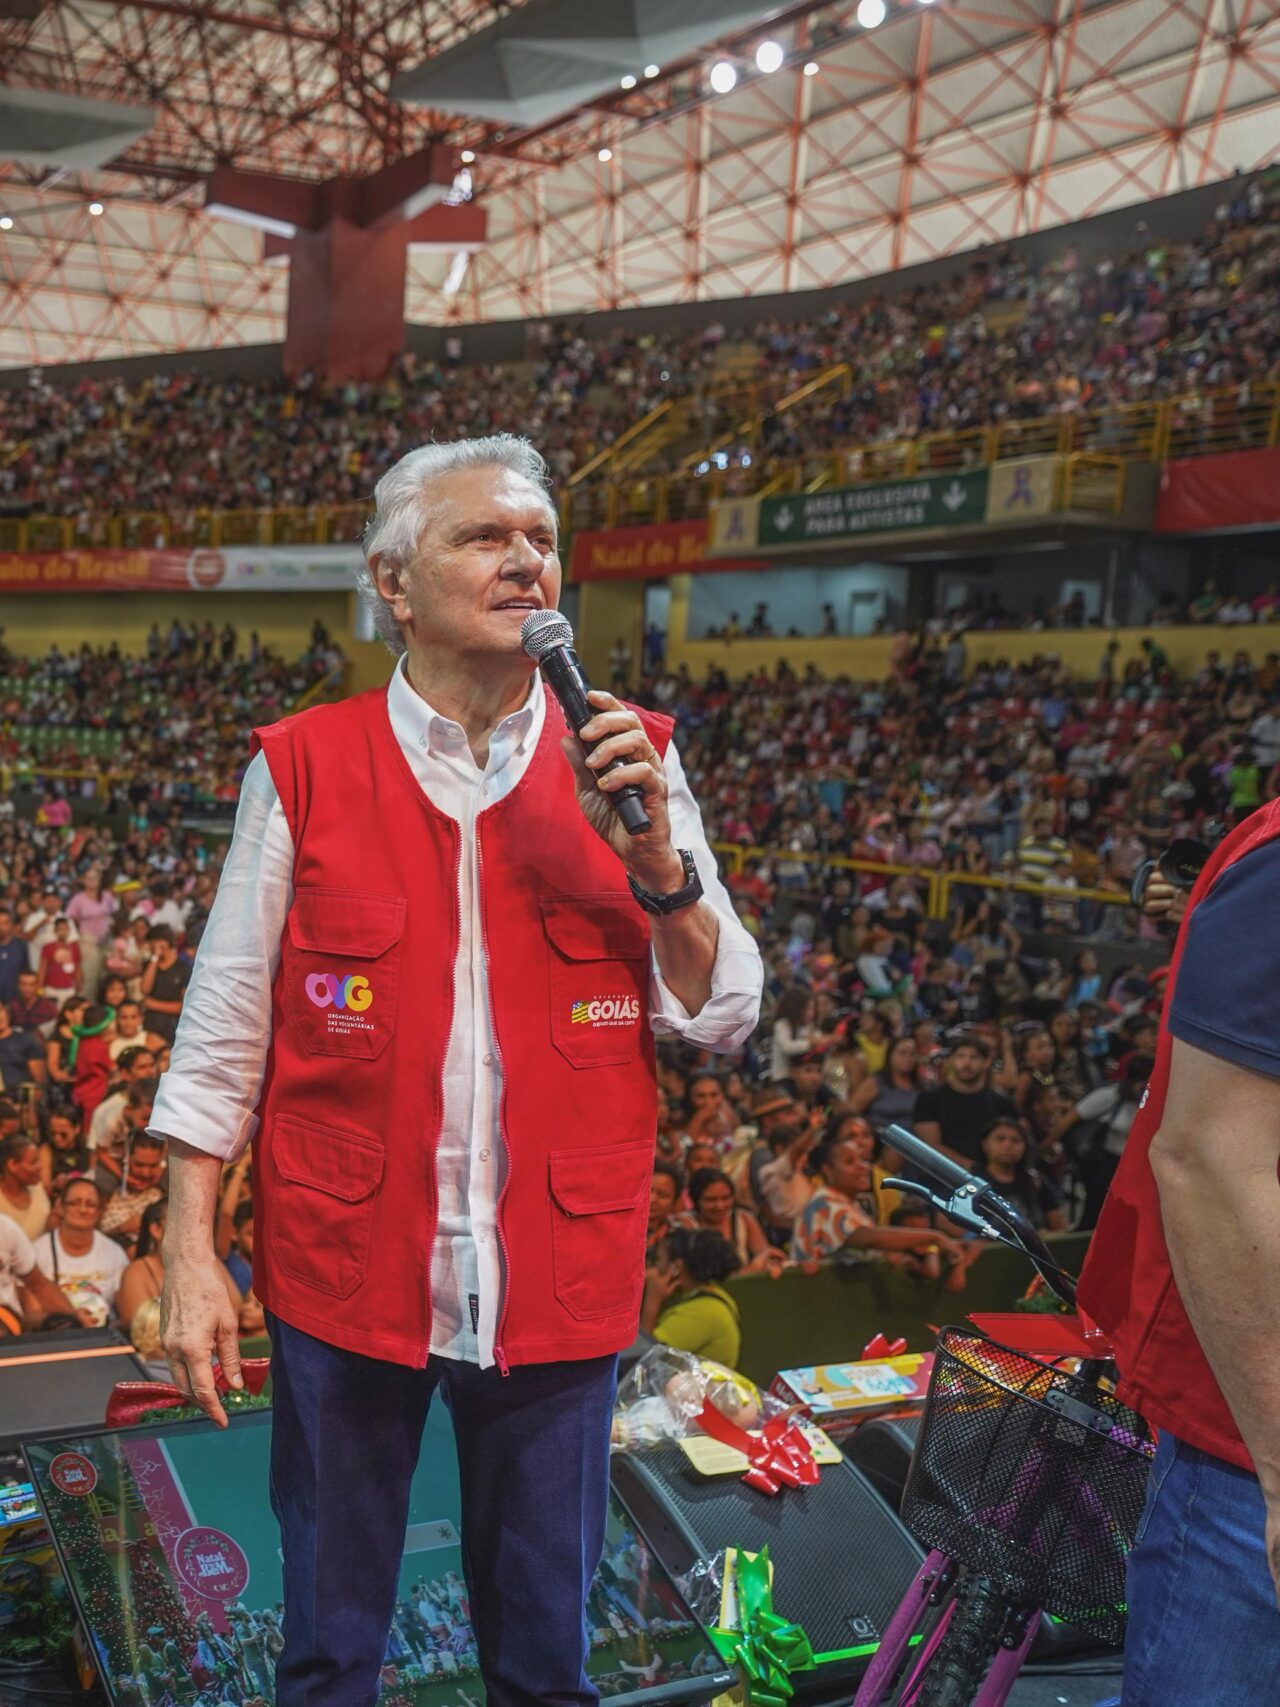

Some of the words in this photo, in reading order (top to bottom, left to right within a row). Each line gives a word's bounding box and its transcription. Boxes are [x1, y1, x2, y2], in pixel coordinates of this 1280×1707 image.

[848, 504, 925, 530] AUTISTAS
[590, 540, 642, 569] Natal
[645, 539, 675, 567] do
[44, 558, 70, 580] do
[305, 973, 373, 1012] OVG
[327, 1013, 365, 1022] ORGANIZAÇÃO
[588, 996, 640, 1020] GOIÁS
[338, 1021, 375, 1030] VOLUNTÁRIAS
